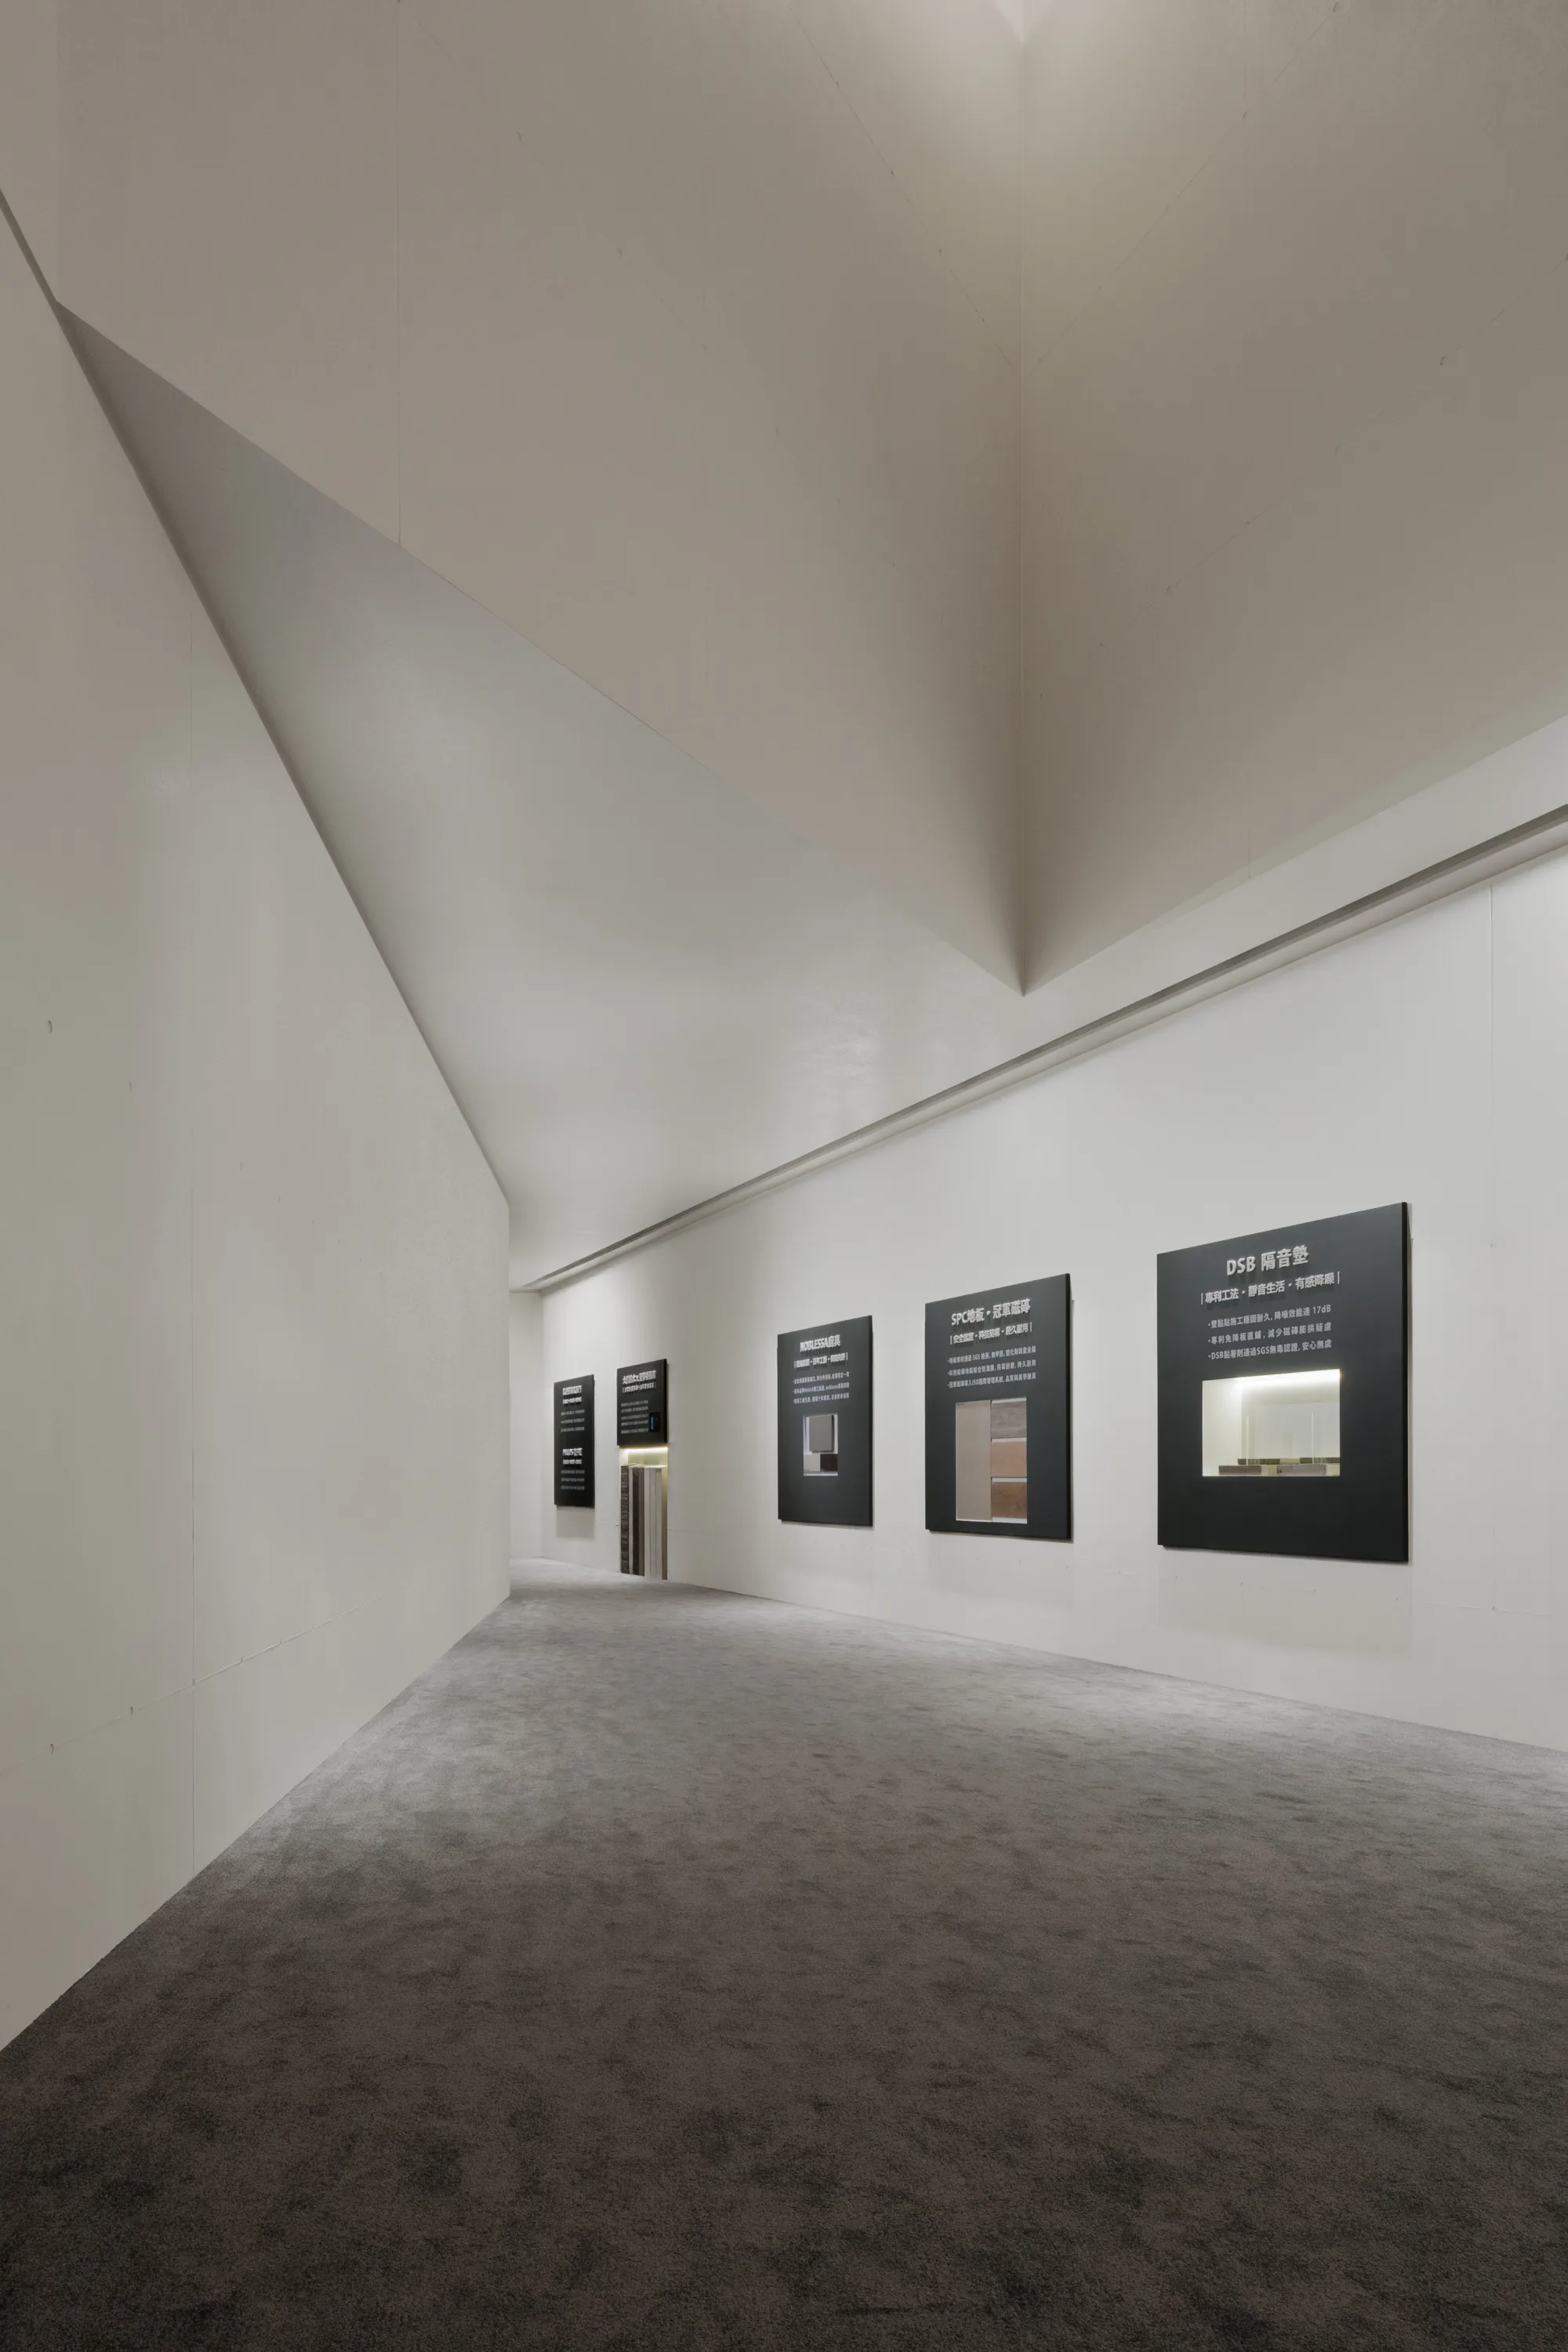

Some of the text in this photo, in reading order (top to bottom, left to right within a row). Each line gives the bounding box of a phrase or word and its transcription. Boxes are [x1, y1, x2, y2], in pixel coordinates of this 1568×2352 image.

[1226, 1245, 1309, 1276] DSB 隔音墊
